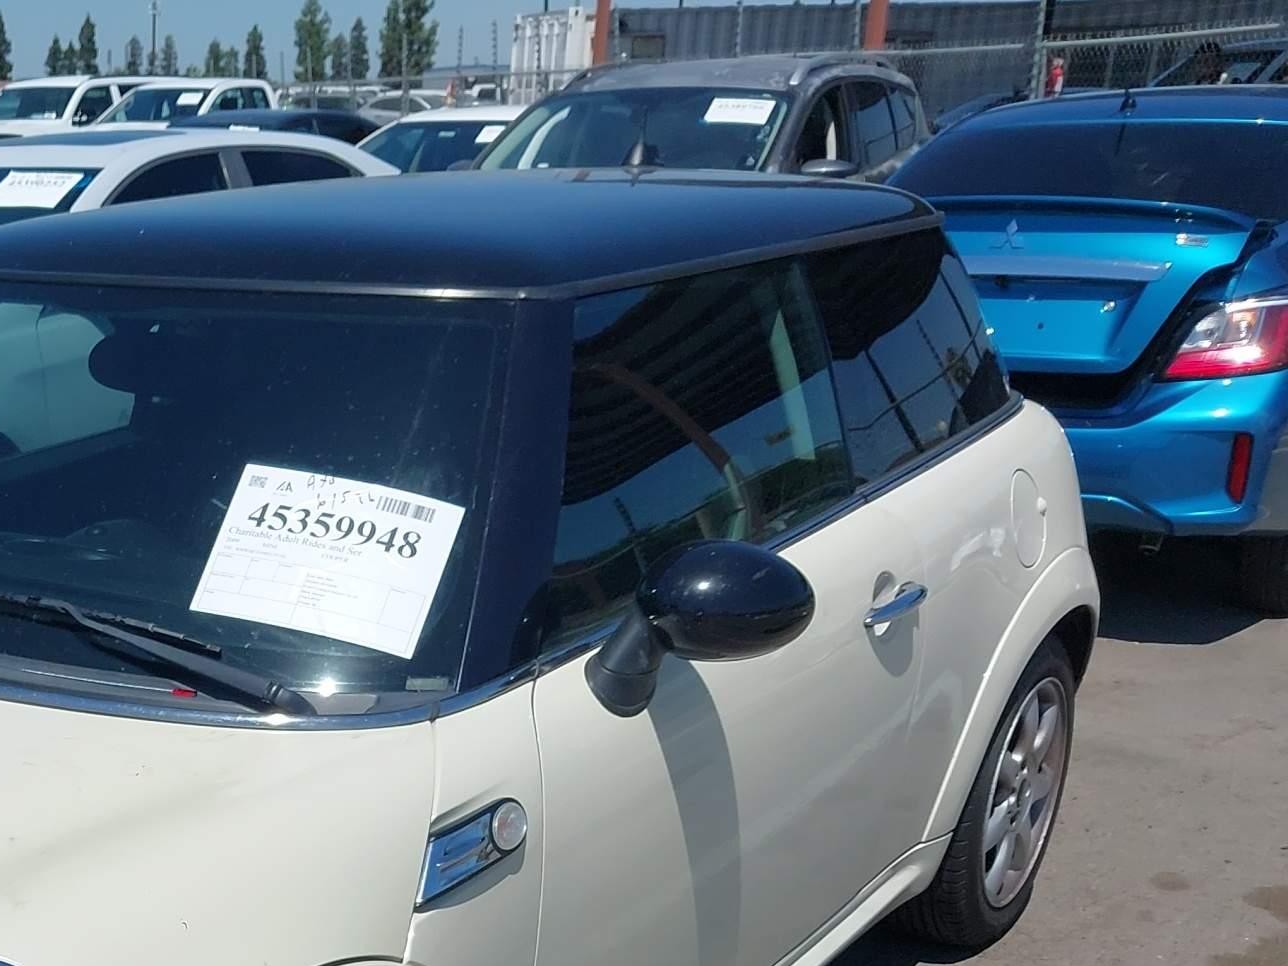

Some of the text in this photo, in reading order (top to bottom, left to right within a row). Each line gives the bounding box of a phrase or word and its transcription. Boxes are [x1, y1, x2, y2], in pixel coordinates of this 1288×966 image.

[228, 526, 273, 541] Charitable
[276, 532, 300, 545] Adult
[301, 537, 327, 550] Rides
[328, 541, 347, 553] and
[247, 501, 422, 559] 45359948
